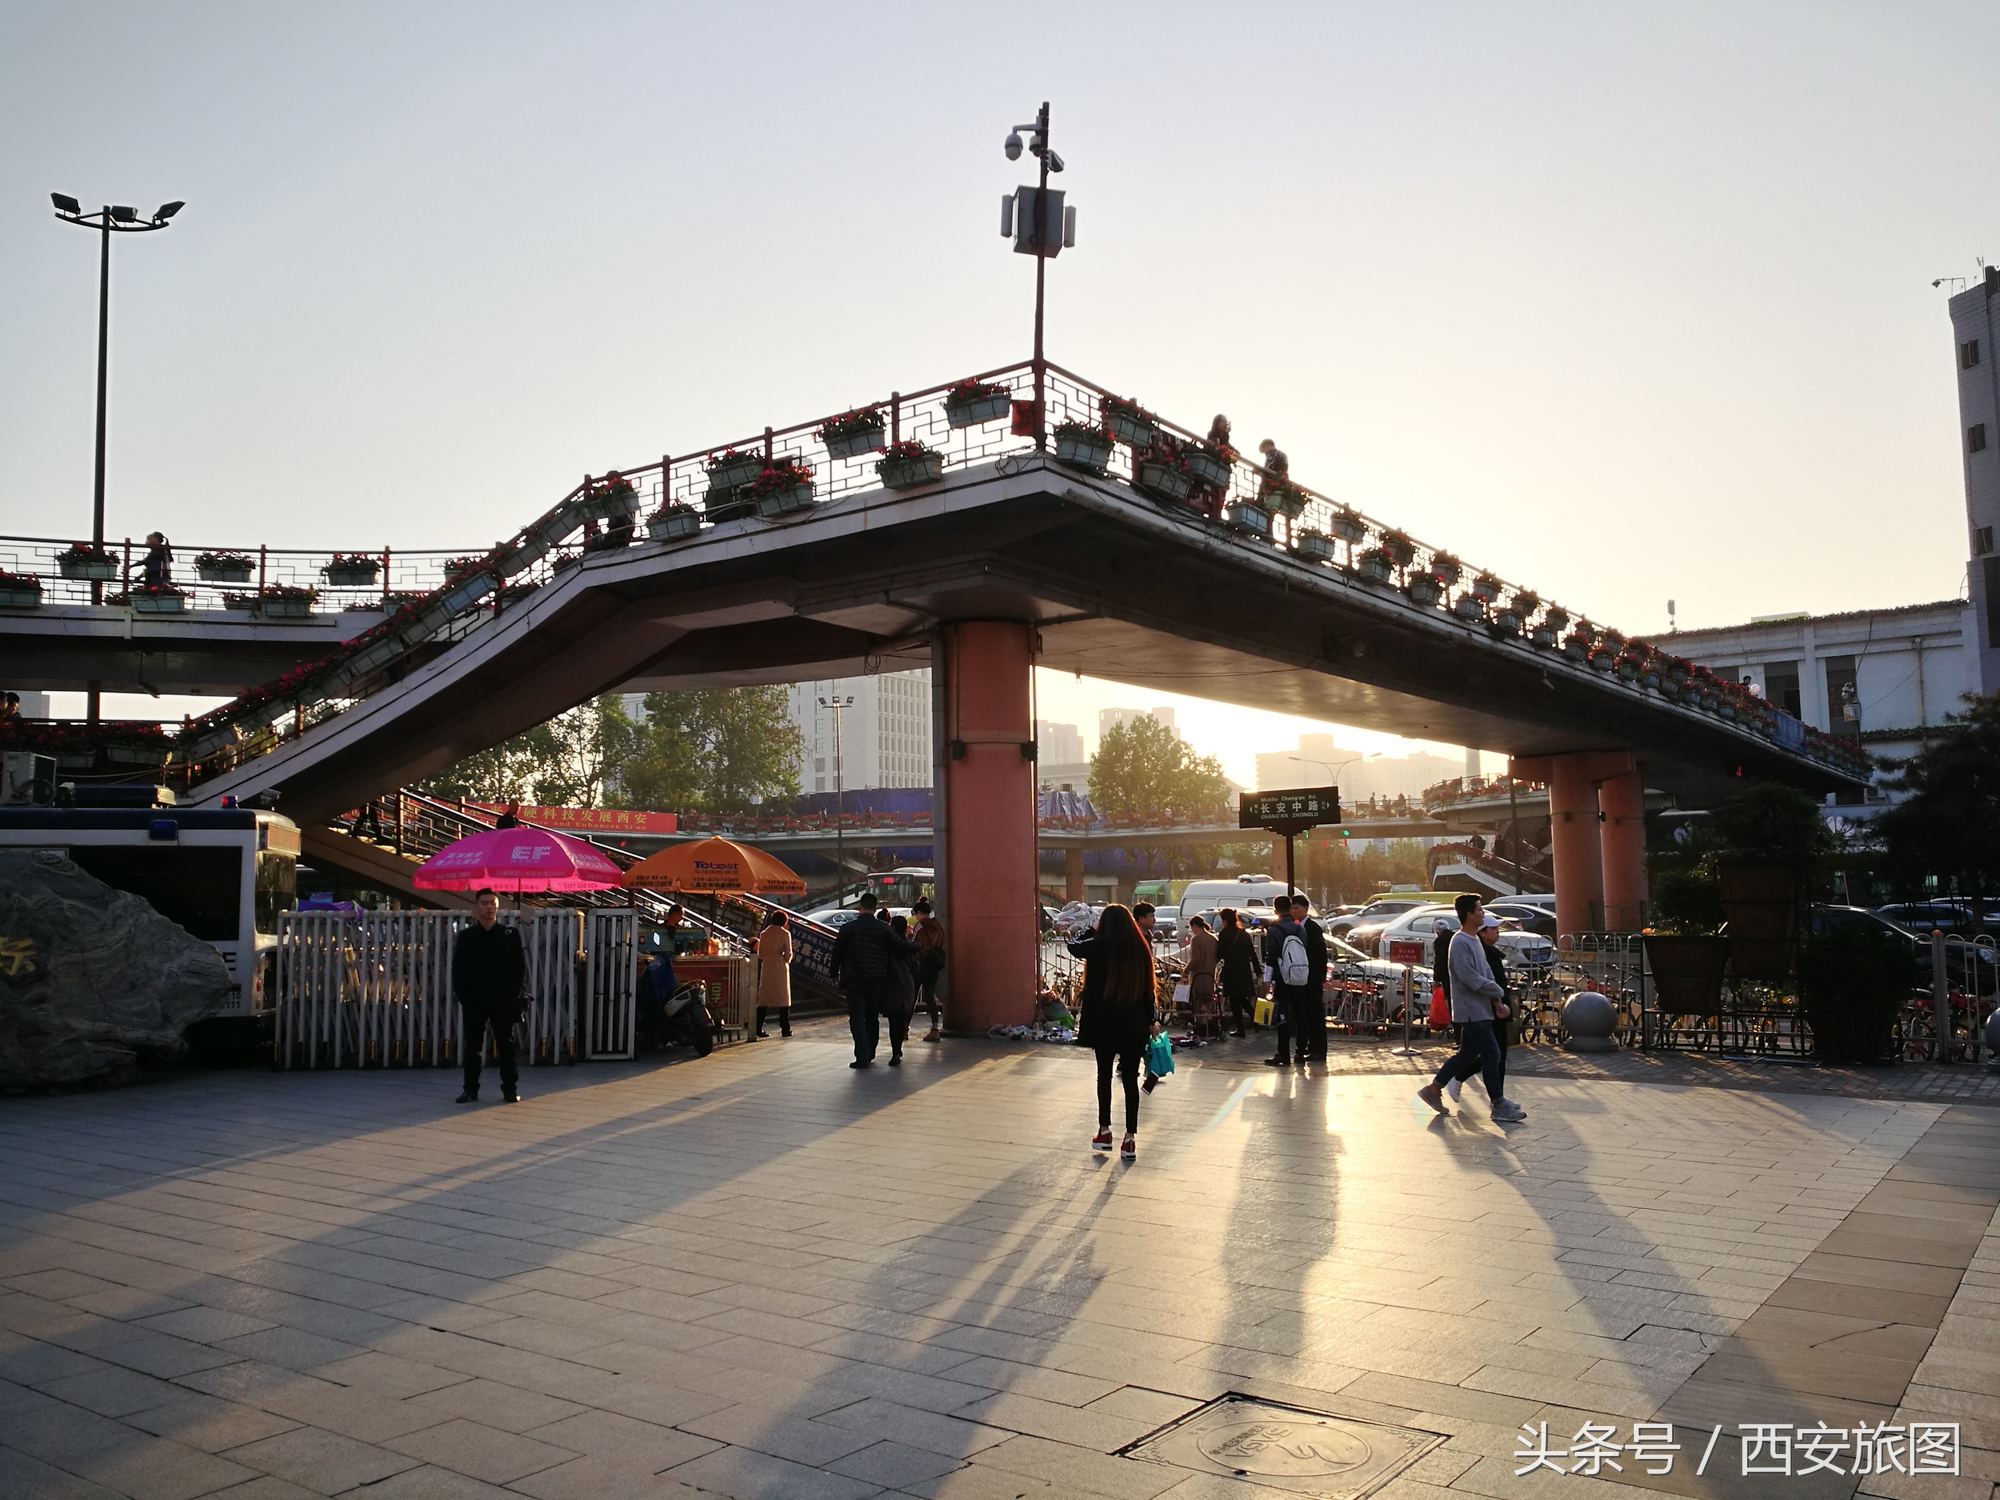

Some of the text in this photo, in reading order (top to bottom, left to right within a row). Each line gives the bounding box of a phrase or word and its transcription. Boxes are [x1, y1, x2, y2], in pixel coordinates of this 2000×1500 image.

[1260, 800, 1318, 813] 长安中路
[523, 807, 648, 825] 硬科技发展西安
[575, 821, 620, 829] Enhances
